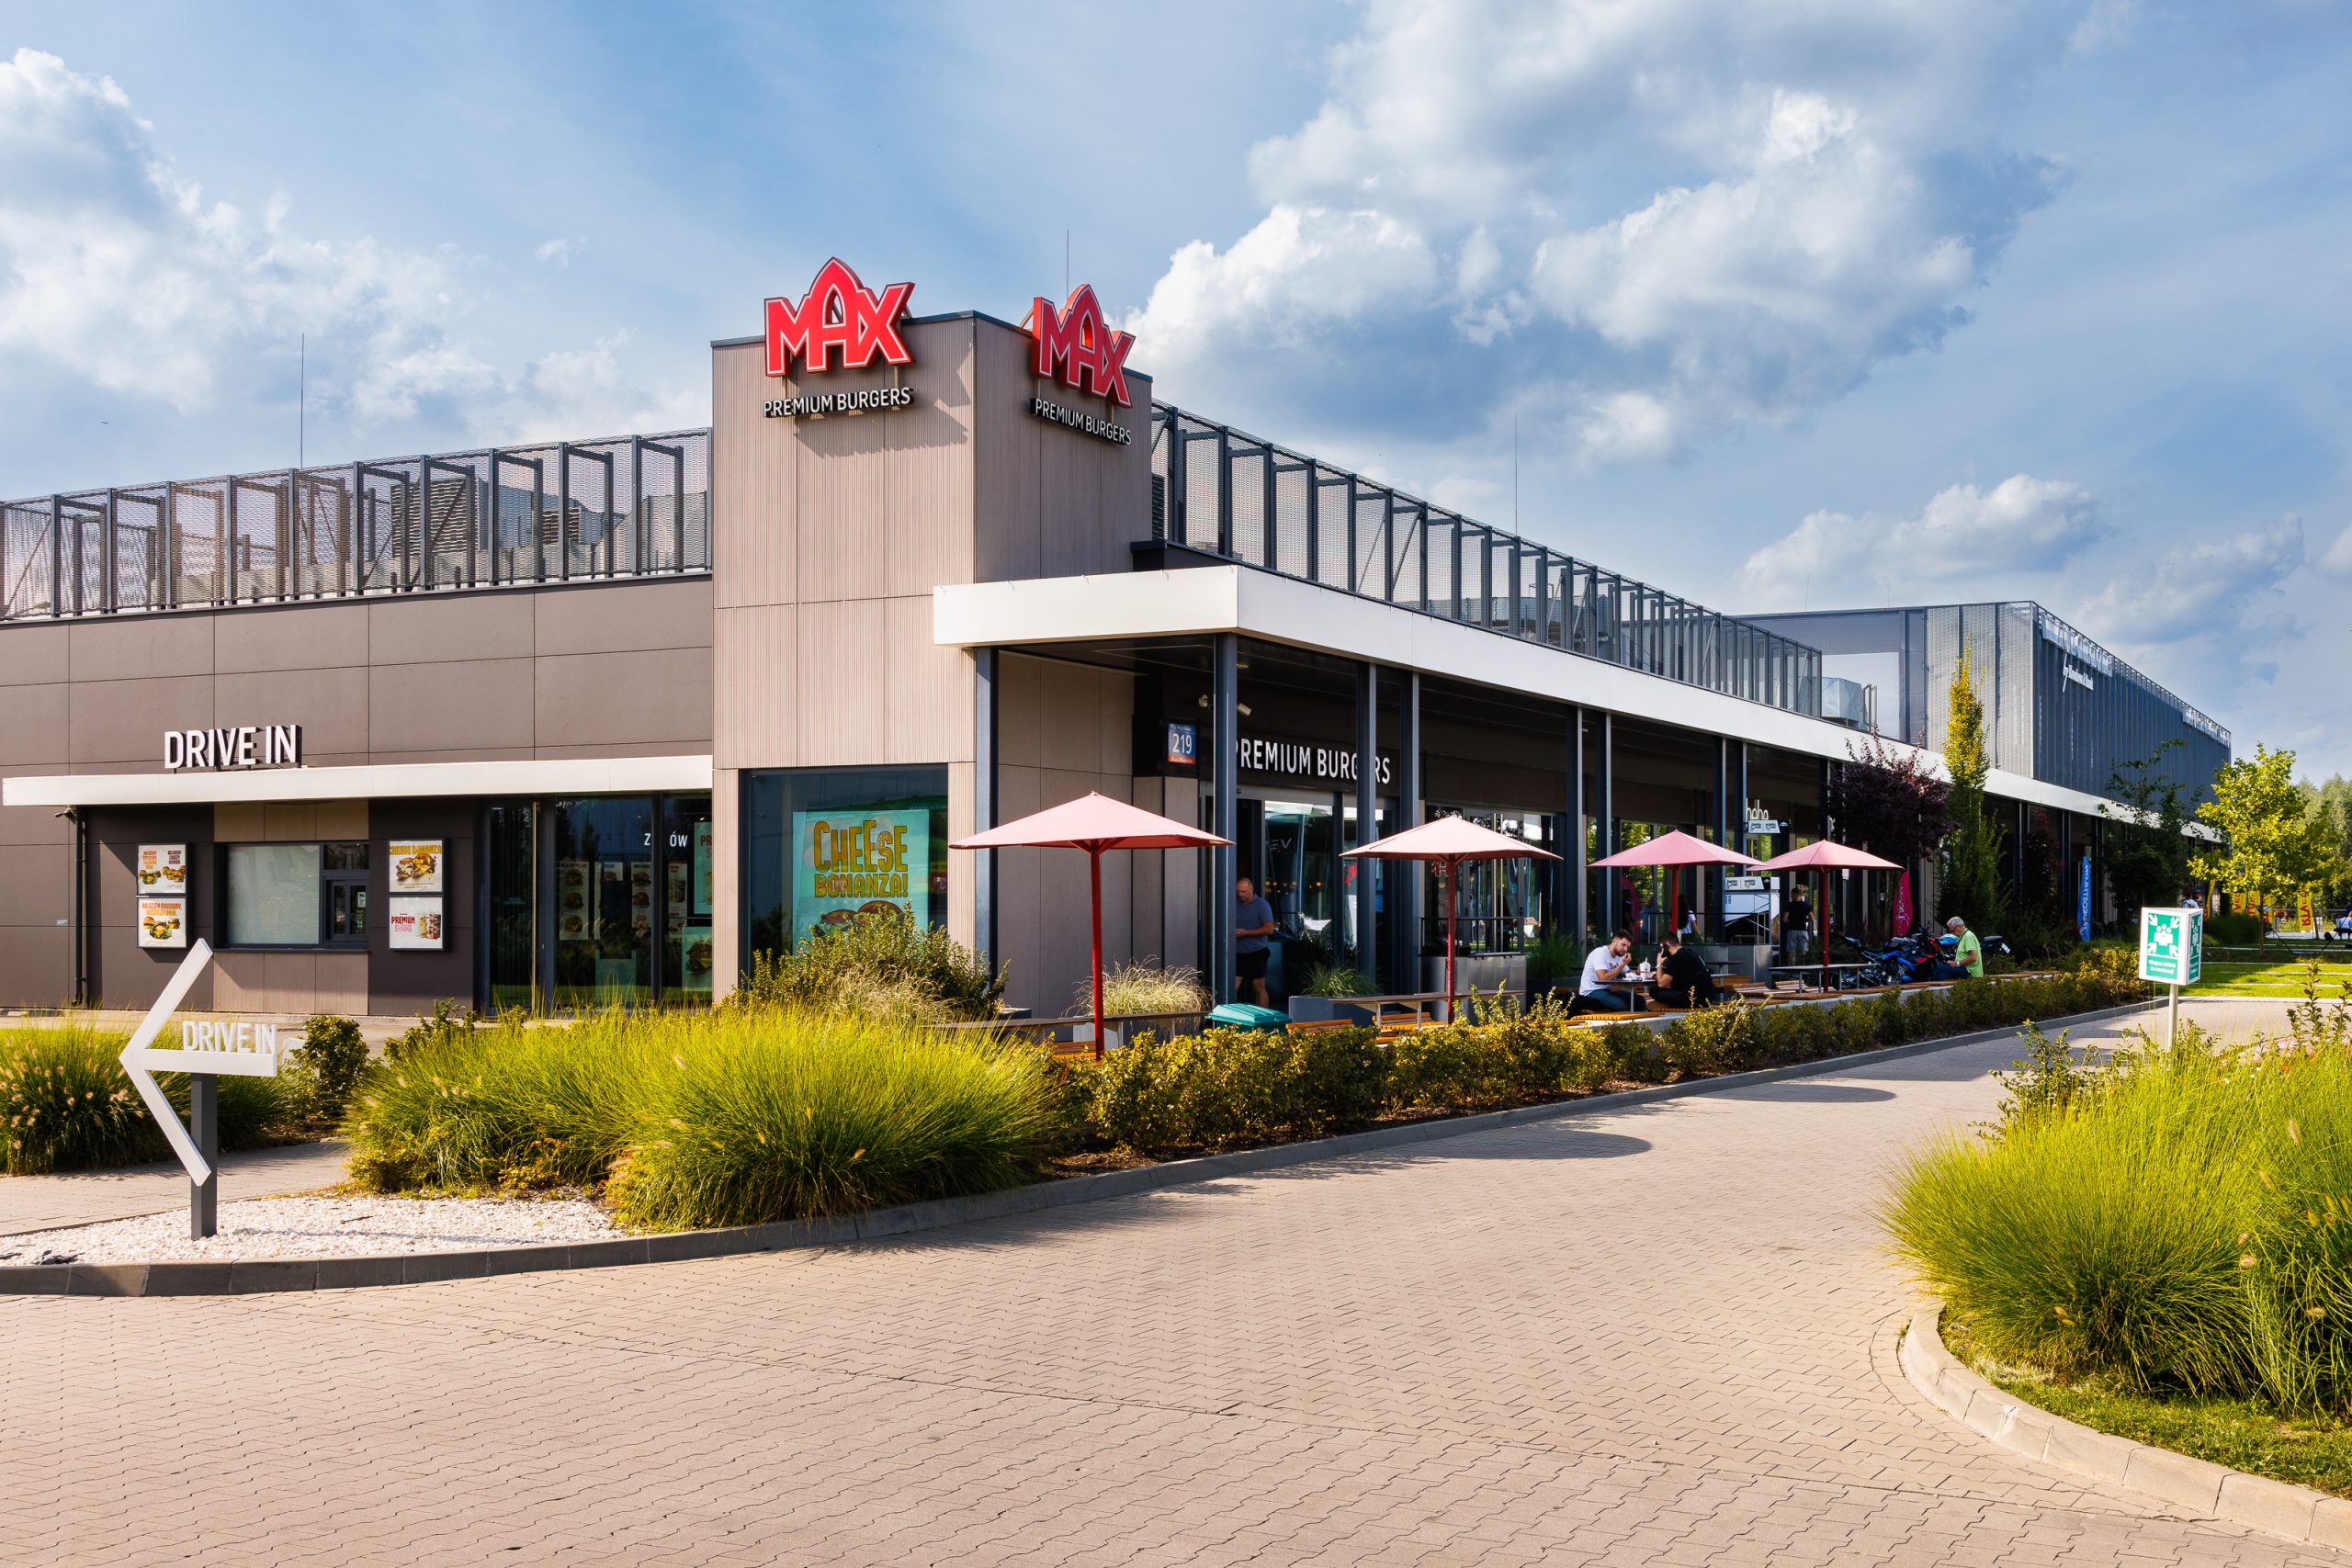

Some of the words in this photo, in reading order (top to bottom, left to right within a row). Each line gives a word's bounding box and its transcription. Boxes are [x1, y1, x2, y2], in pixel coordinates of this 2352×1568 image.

[764, 256, 915, 378] MAX
[1032, 283, 1136, 408] MAX
[763, 394, 833, 417] PREMIUM
[837, 386, 911, 411] BURGERS
[1035, 397, 1084, 430] PREMIUM
[1085, 415, 1132, 446] BURGERS
[164, 726, 257, 769] DRIVE
[265, 724, 298, 764] IN
[1172, 732, 1193, 754] 219
[1236, 738, 1311, 775] REMIUM
[1317, 748, 1391, 784] BURGRS
[813, 819, 909, 873] CHEESE
[814, 873, 909, 897] BONANZA!
[183, 1021, 252, 1053] DRIVE
[254, 1023, 277, 1055] IN
